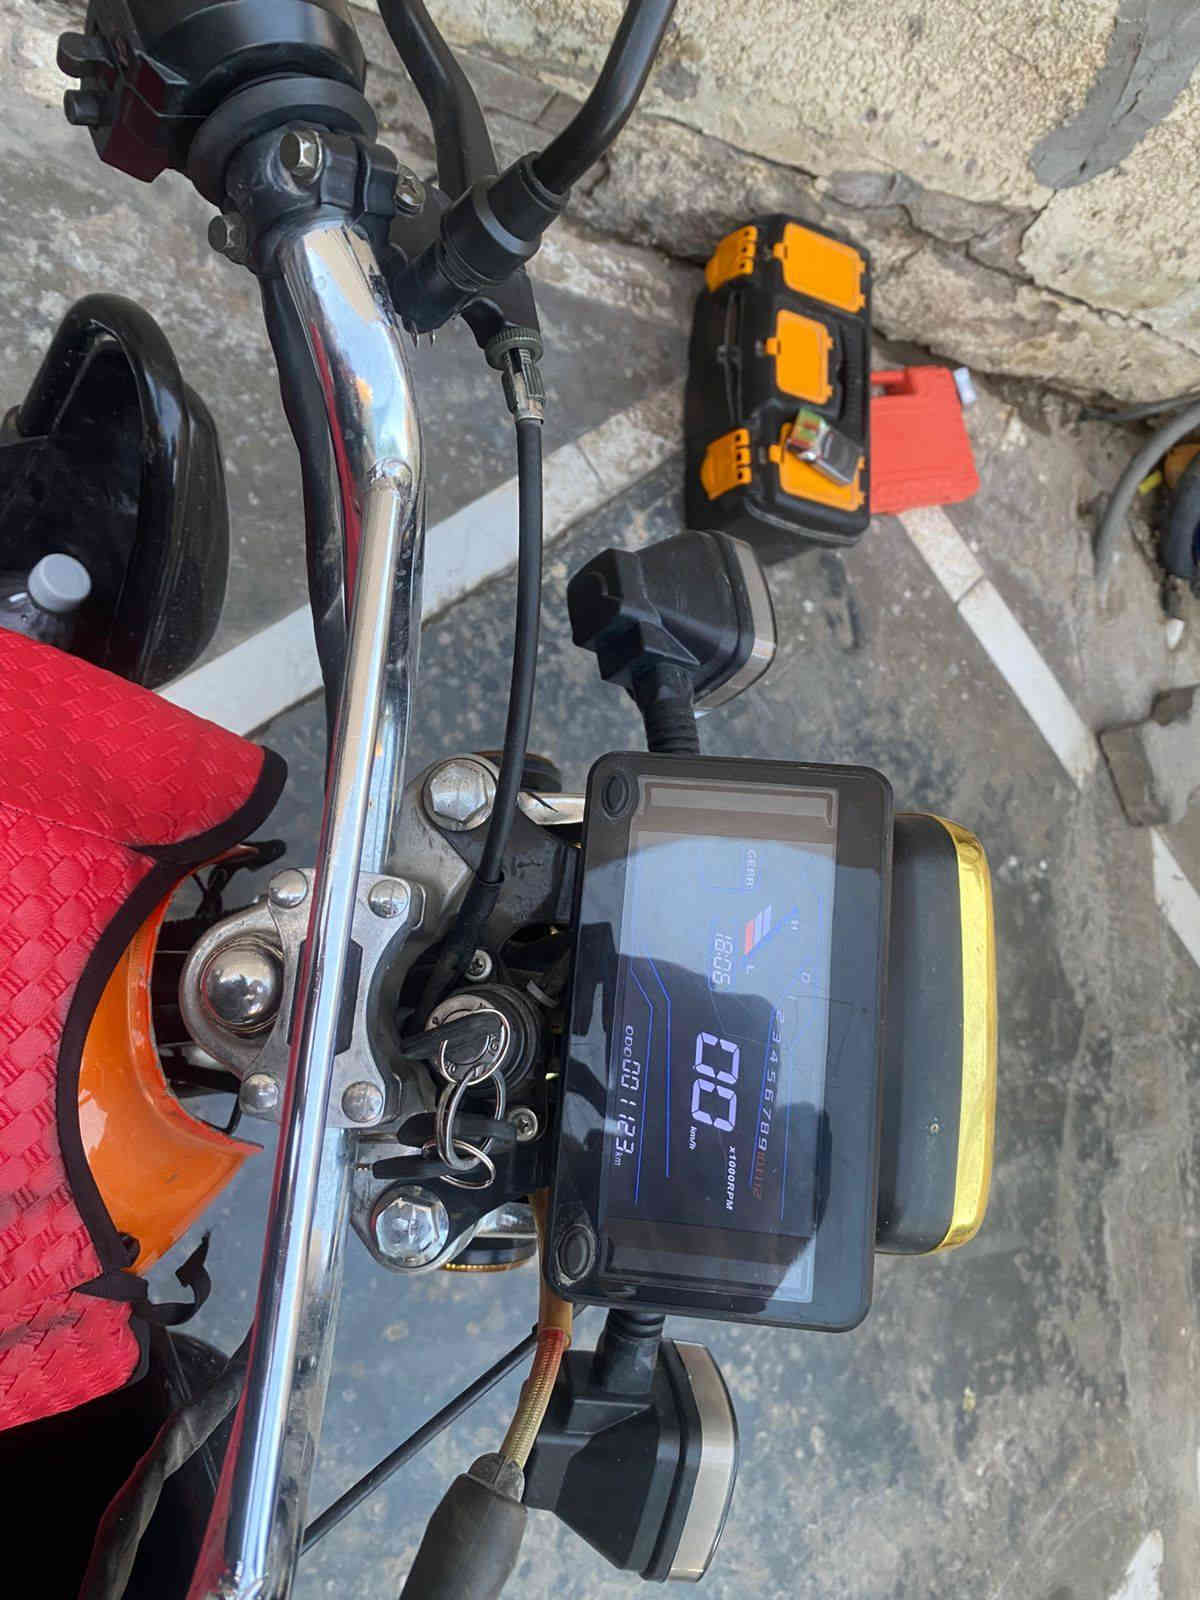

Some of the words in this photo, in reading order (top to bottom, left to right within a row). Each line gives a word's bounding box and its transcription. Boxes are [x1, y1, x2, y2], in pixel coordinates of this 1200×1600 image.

[772, 1031, 782, 1043] 3
[769, 1049, 779, 1063] 4
[691, 1032, 740, 1132] 00
[766, 1070, 777, 1083] 5
[764, 1088, 775, 1102] 6
[761, 1107, 772, 1120] 7
[759, 1121, 770, 1134] 8
[687, 1125, 698, 1152] km/h
